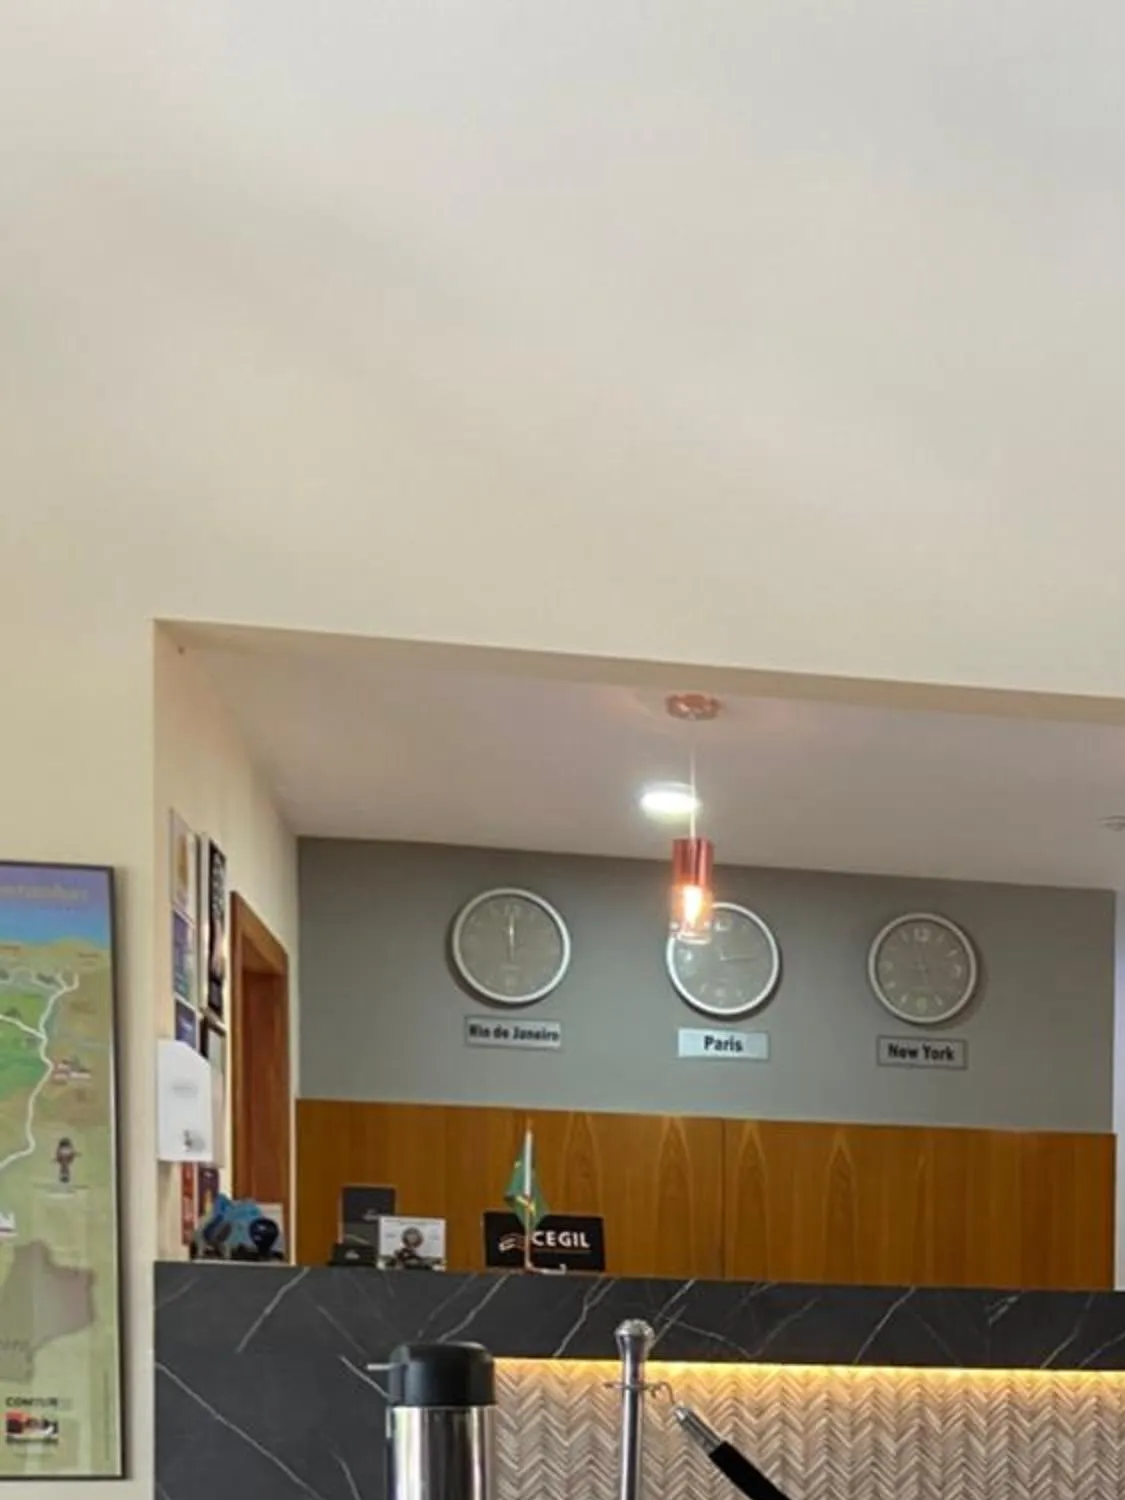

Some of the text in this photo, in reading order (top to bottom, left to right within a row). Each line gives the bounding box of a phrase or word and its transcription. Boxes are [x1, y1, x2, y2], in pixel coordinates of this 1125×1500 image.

[469, 1024, 560, 1042] Rio de Janeiro
[704, 1035, 743, 1052] Paris
[887, 1042, 954, 1061] New York
[531, 1230, 590, 1248] CEGIL
